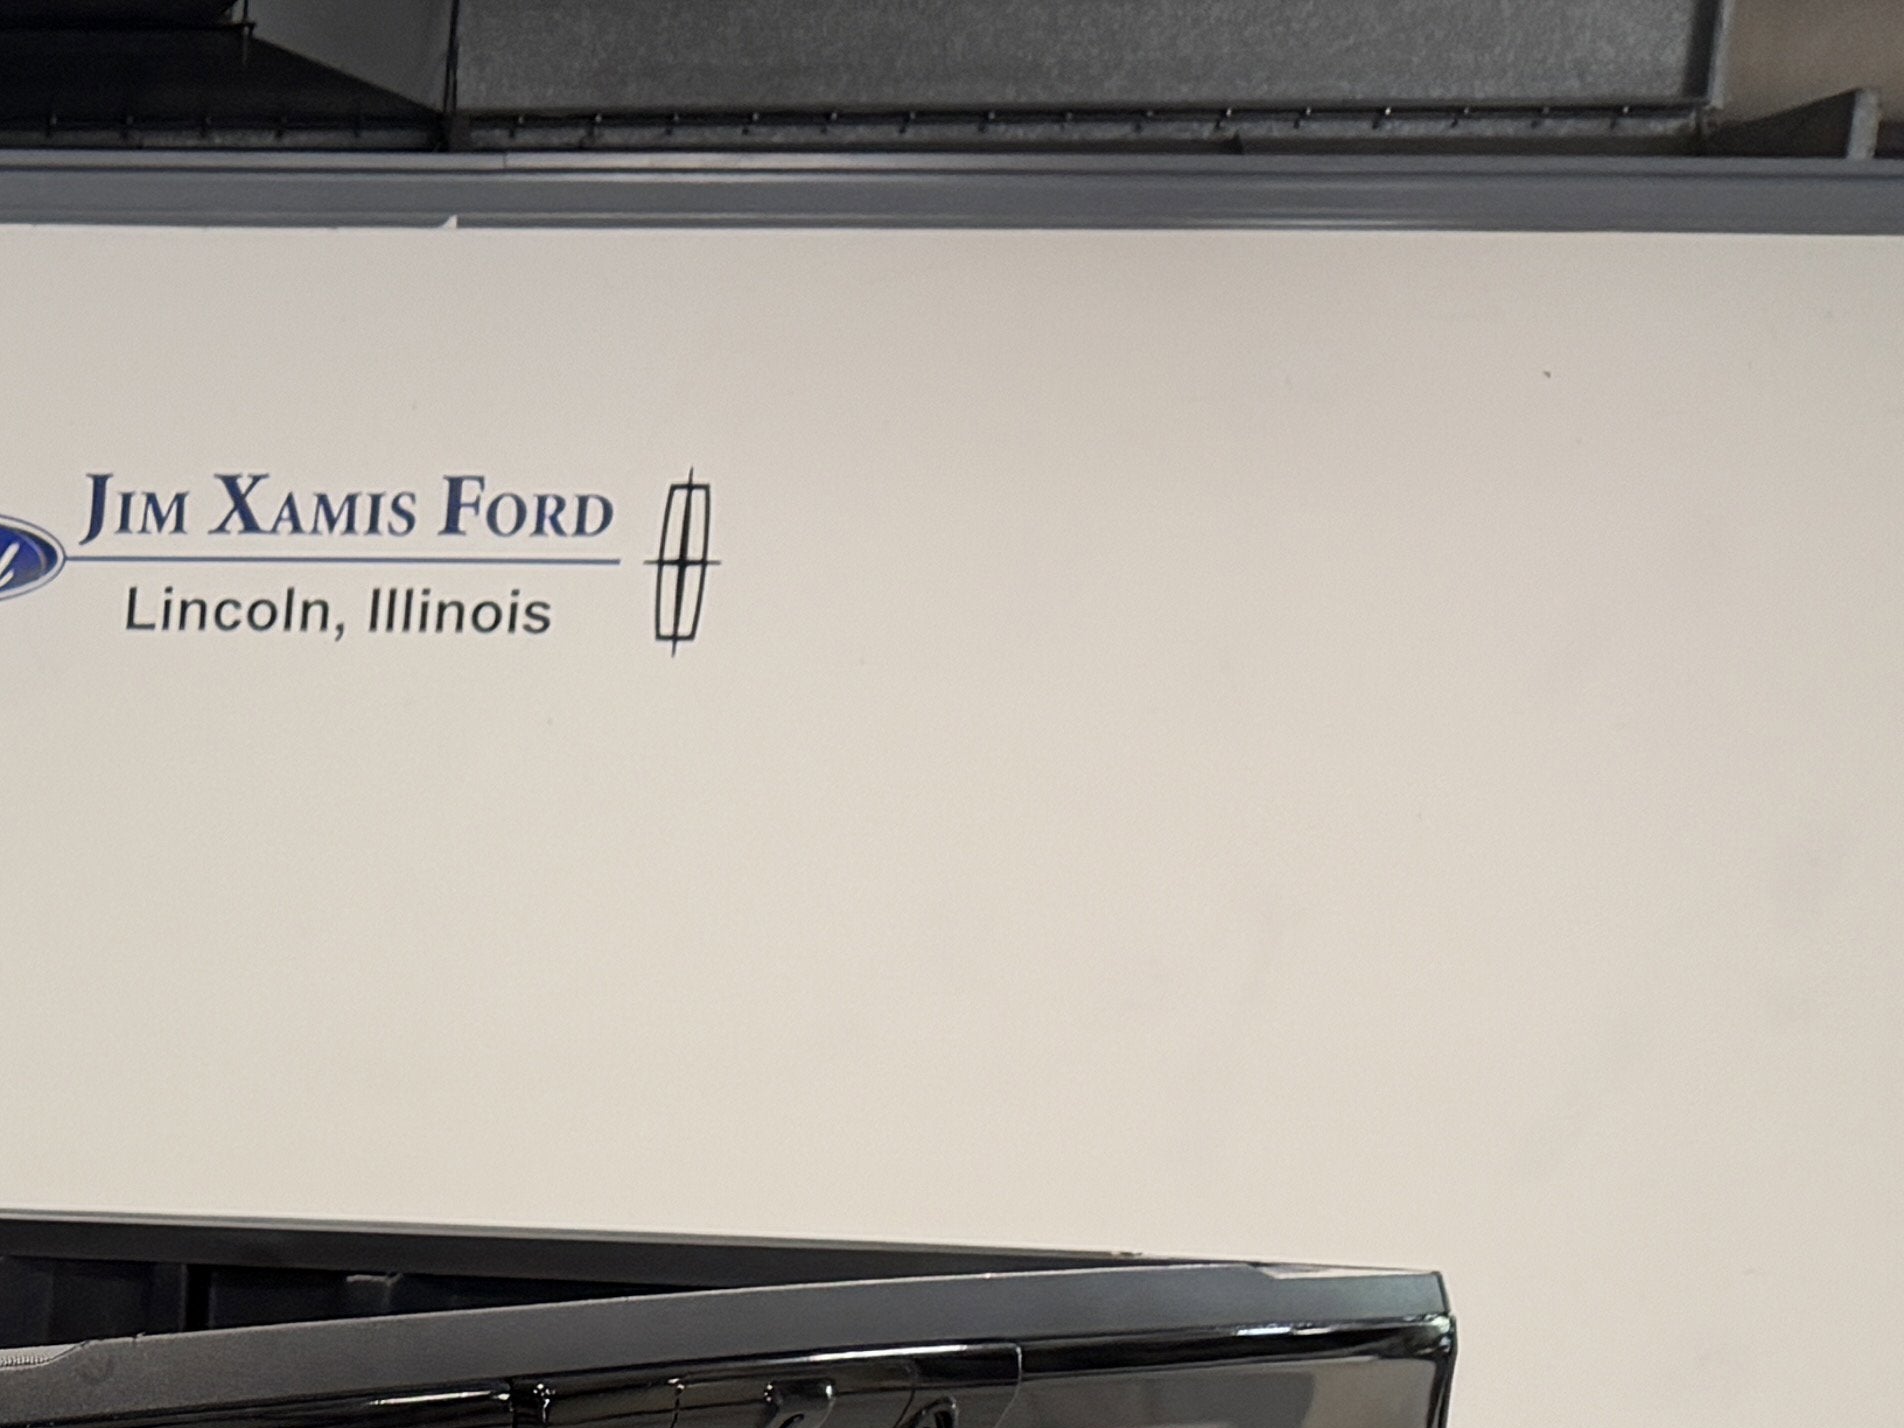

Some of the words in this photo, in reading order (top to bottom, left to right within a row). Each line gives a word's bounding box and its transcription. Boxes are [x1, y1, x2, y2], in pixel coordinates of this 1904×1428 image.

[79, 473, 190, 545] JIM
[207, 473, 416, 537] XAMIS
[437, 475, 614, 537] FORD
[126, 586, 345, 640] Lincoln,
[369, 587, 551, 634] Illinois
